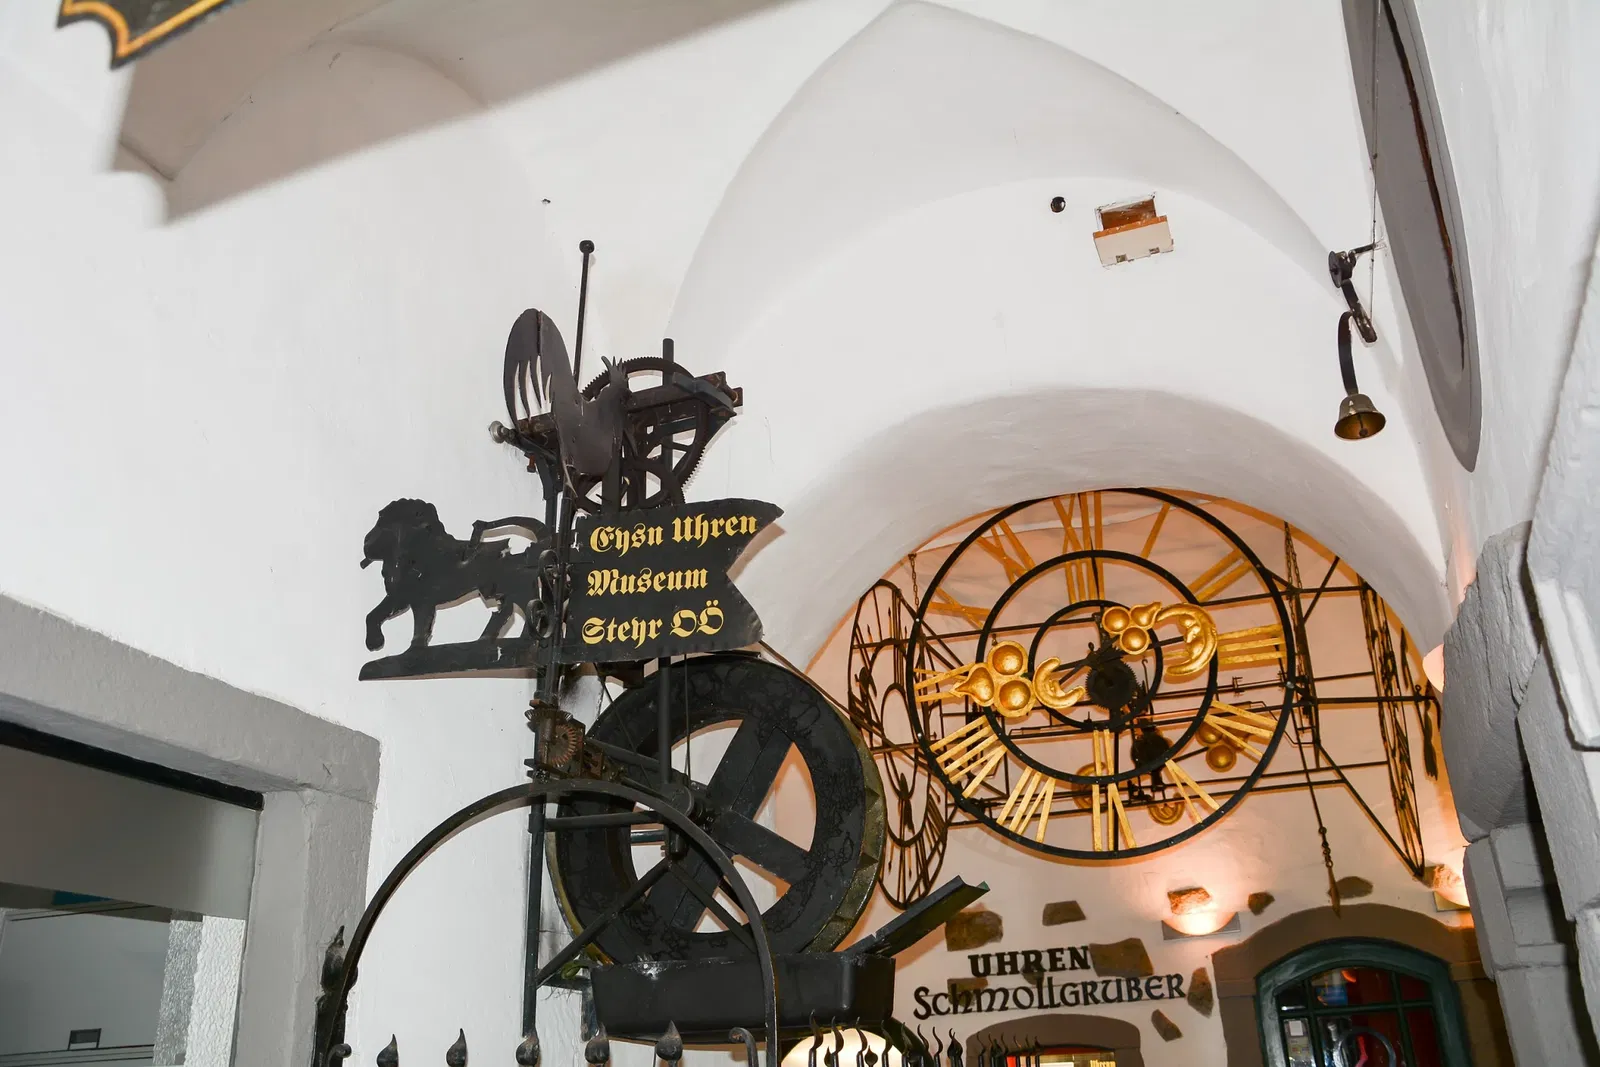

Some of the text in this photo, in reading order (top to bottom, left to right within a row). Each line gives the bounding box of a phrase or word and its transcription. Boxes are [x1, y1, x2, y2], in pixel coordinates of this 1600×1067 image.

[589, 513, 758, 557] Eysn Uhren
[586, 567, 709, 597] Museum
[581, 599, 725, 649] Steyr OÖ
[968, 945, 1091, 978] UHREN
